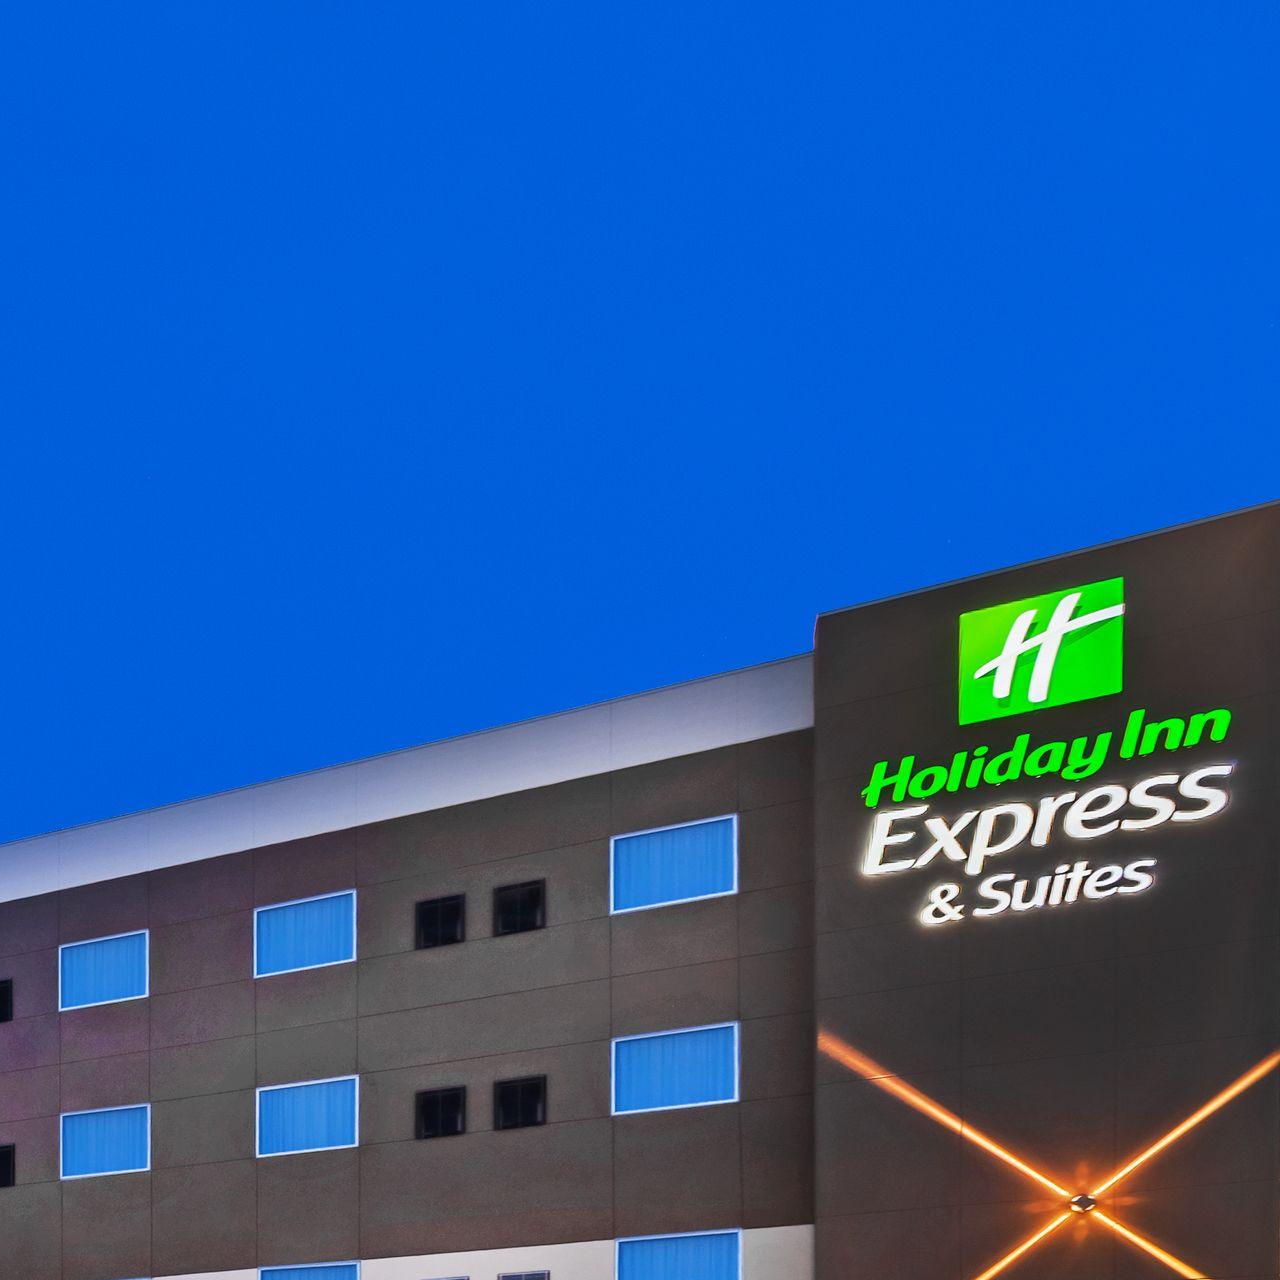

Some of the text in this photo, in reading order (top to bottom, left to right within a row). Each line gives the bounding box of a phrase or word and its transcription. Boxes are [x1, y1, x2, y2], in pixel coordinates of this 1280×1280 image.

[861, 708, 1232, 809] Holiday Inn
[862, 764, 1236, 876] Express
[919, 858, 1158, 925] & Suites
